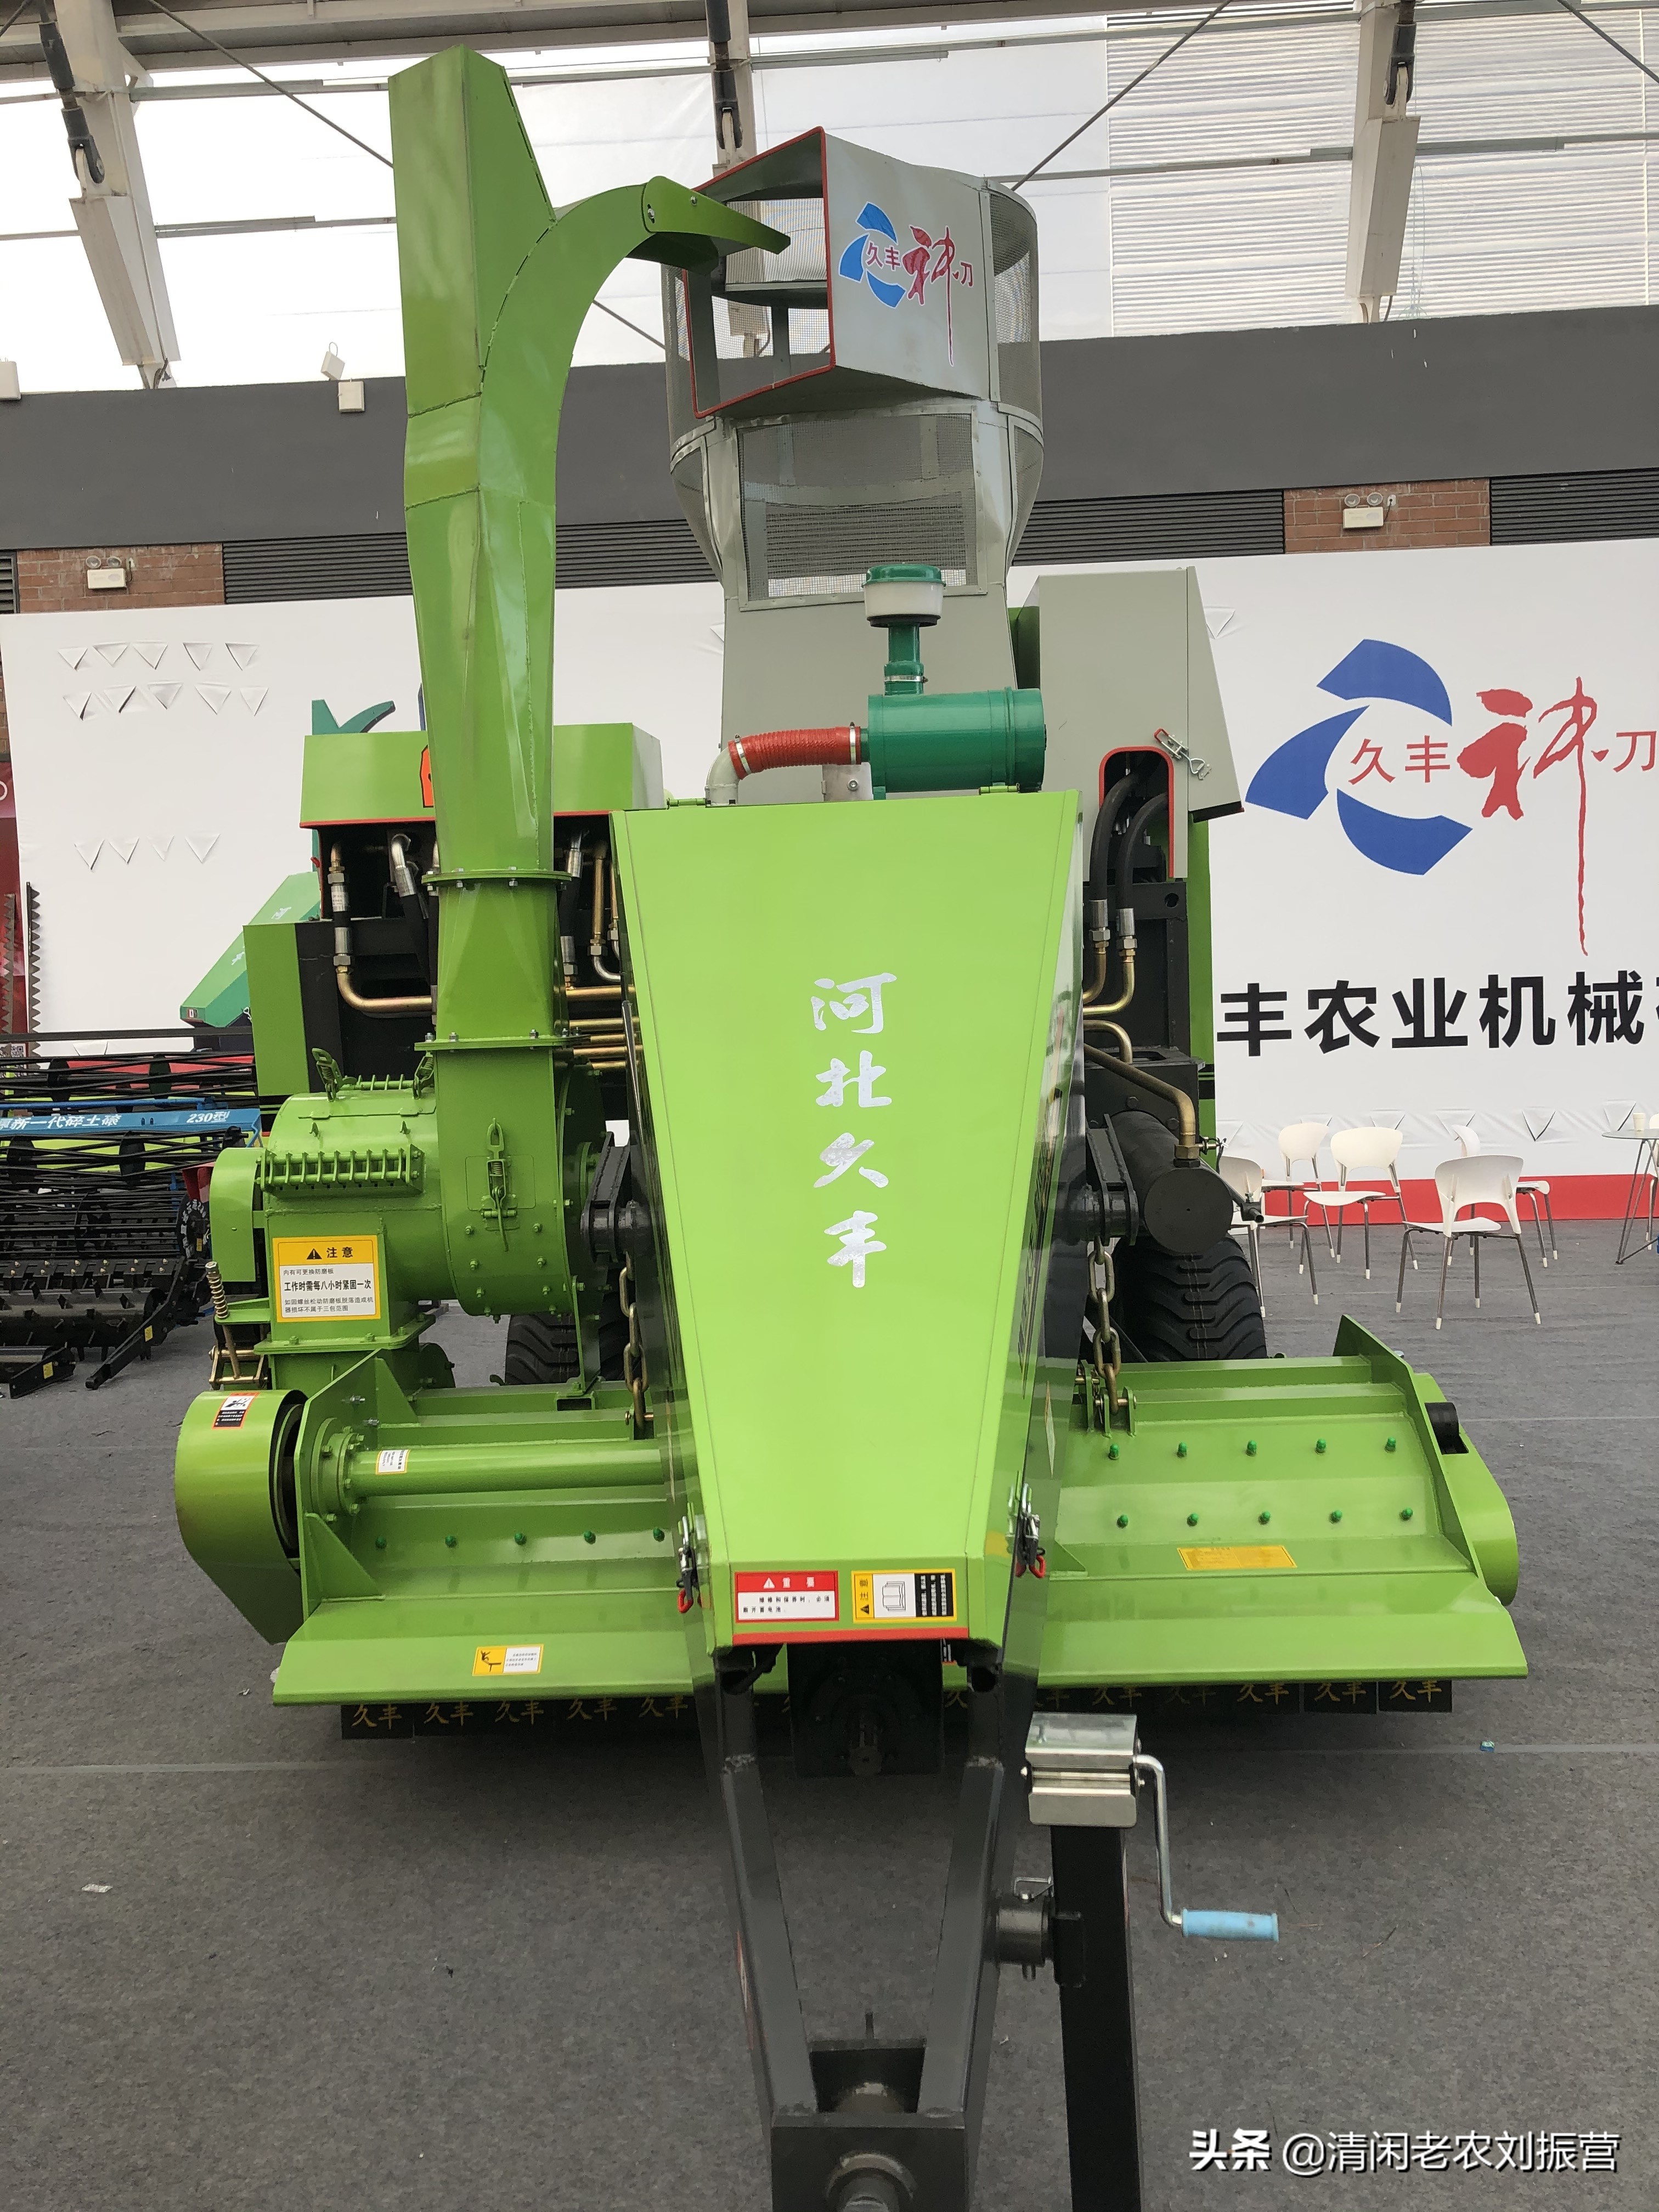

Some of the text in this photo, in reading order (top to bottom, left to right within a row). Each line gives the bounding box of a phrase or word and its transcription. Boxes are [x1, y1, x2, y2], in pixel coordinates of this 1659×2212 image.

[1216, 969, 1659, 1057] 丰农业机械
[186, 1111, 230, 1123] 230型
[810, 972, 898, 1288] 河北久丰
[326, 1246, 353, 1259] 注意
[283, 1268, 334, 1276] 内有可更换防磨板
[284, 1279, 371, 1291] 工作时需每八小时紧固一次
[351, 1703, 402, 1729] 久丰
[424, 1701, 473, 1726] 久丰
[495, 1700, 544, 1724] 久丰
[566, 1698, 617, 1721] 久丰
